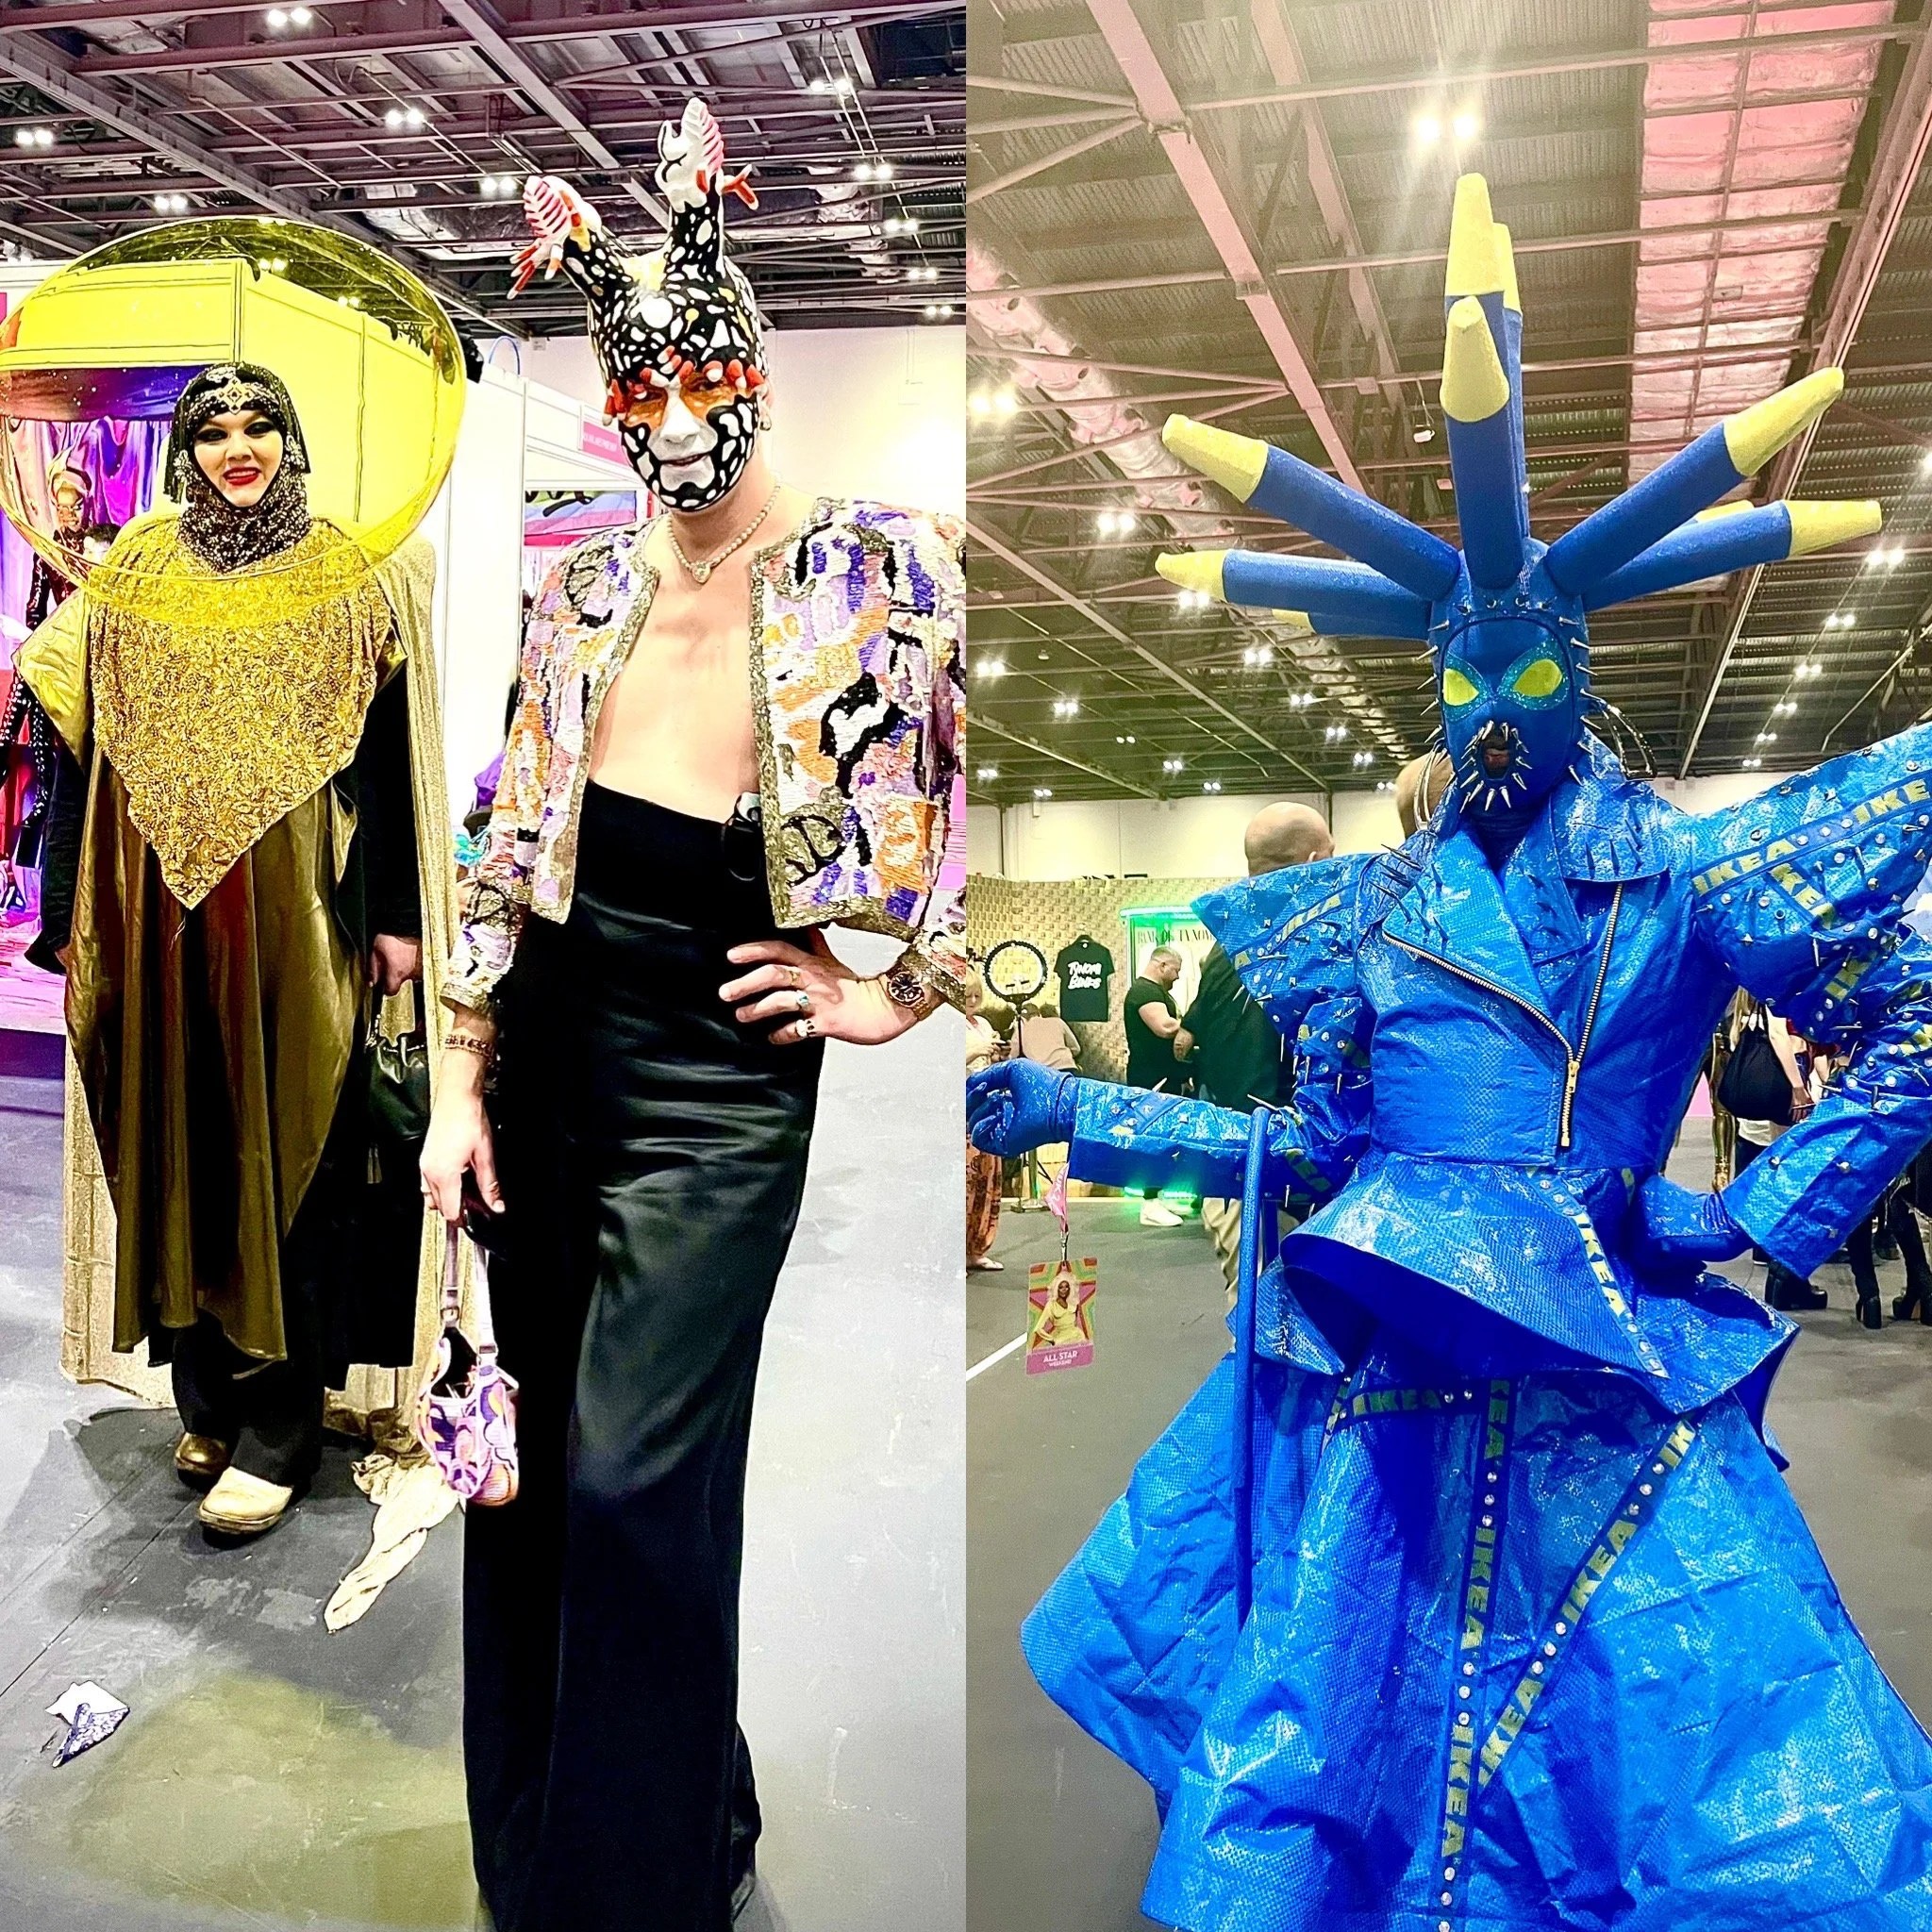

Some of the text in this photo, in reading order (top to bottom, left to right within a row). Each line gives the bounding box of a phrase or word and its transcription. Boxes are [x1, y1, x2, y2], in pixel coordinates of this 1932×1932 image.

[1690, 839, 1798, 896] IKEA
[1573, 1211, 1628, 1317] IKEA
[1043, 1350, 1078, 1363] ALL STAR
[1352, 1389, 1441, 1417] IKEA
[1460, 1525, 1496, 1650] IKEA
[1561, 1519, 1639, 1623] IKEA
[1478, 1677, 1545, 1788] IKEA
[1441, 1723, 1474, 1857] IKEA
